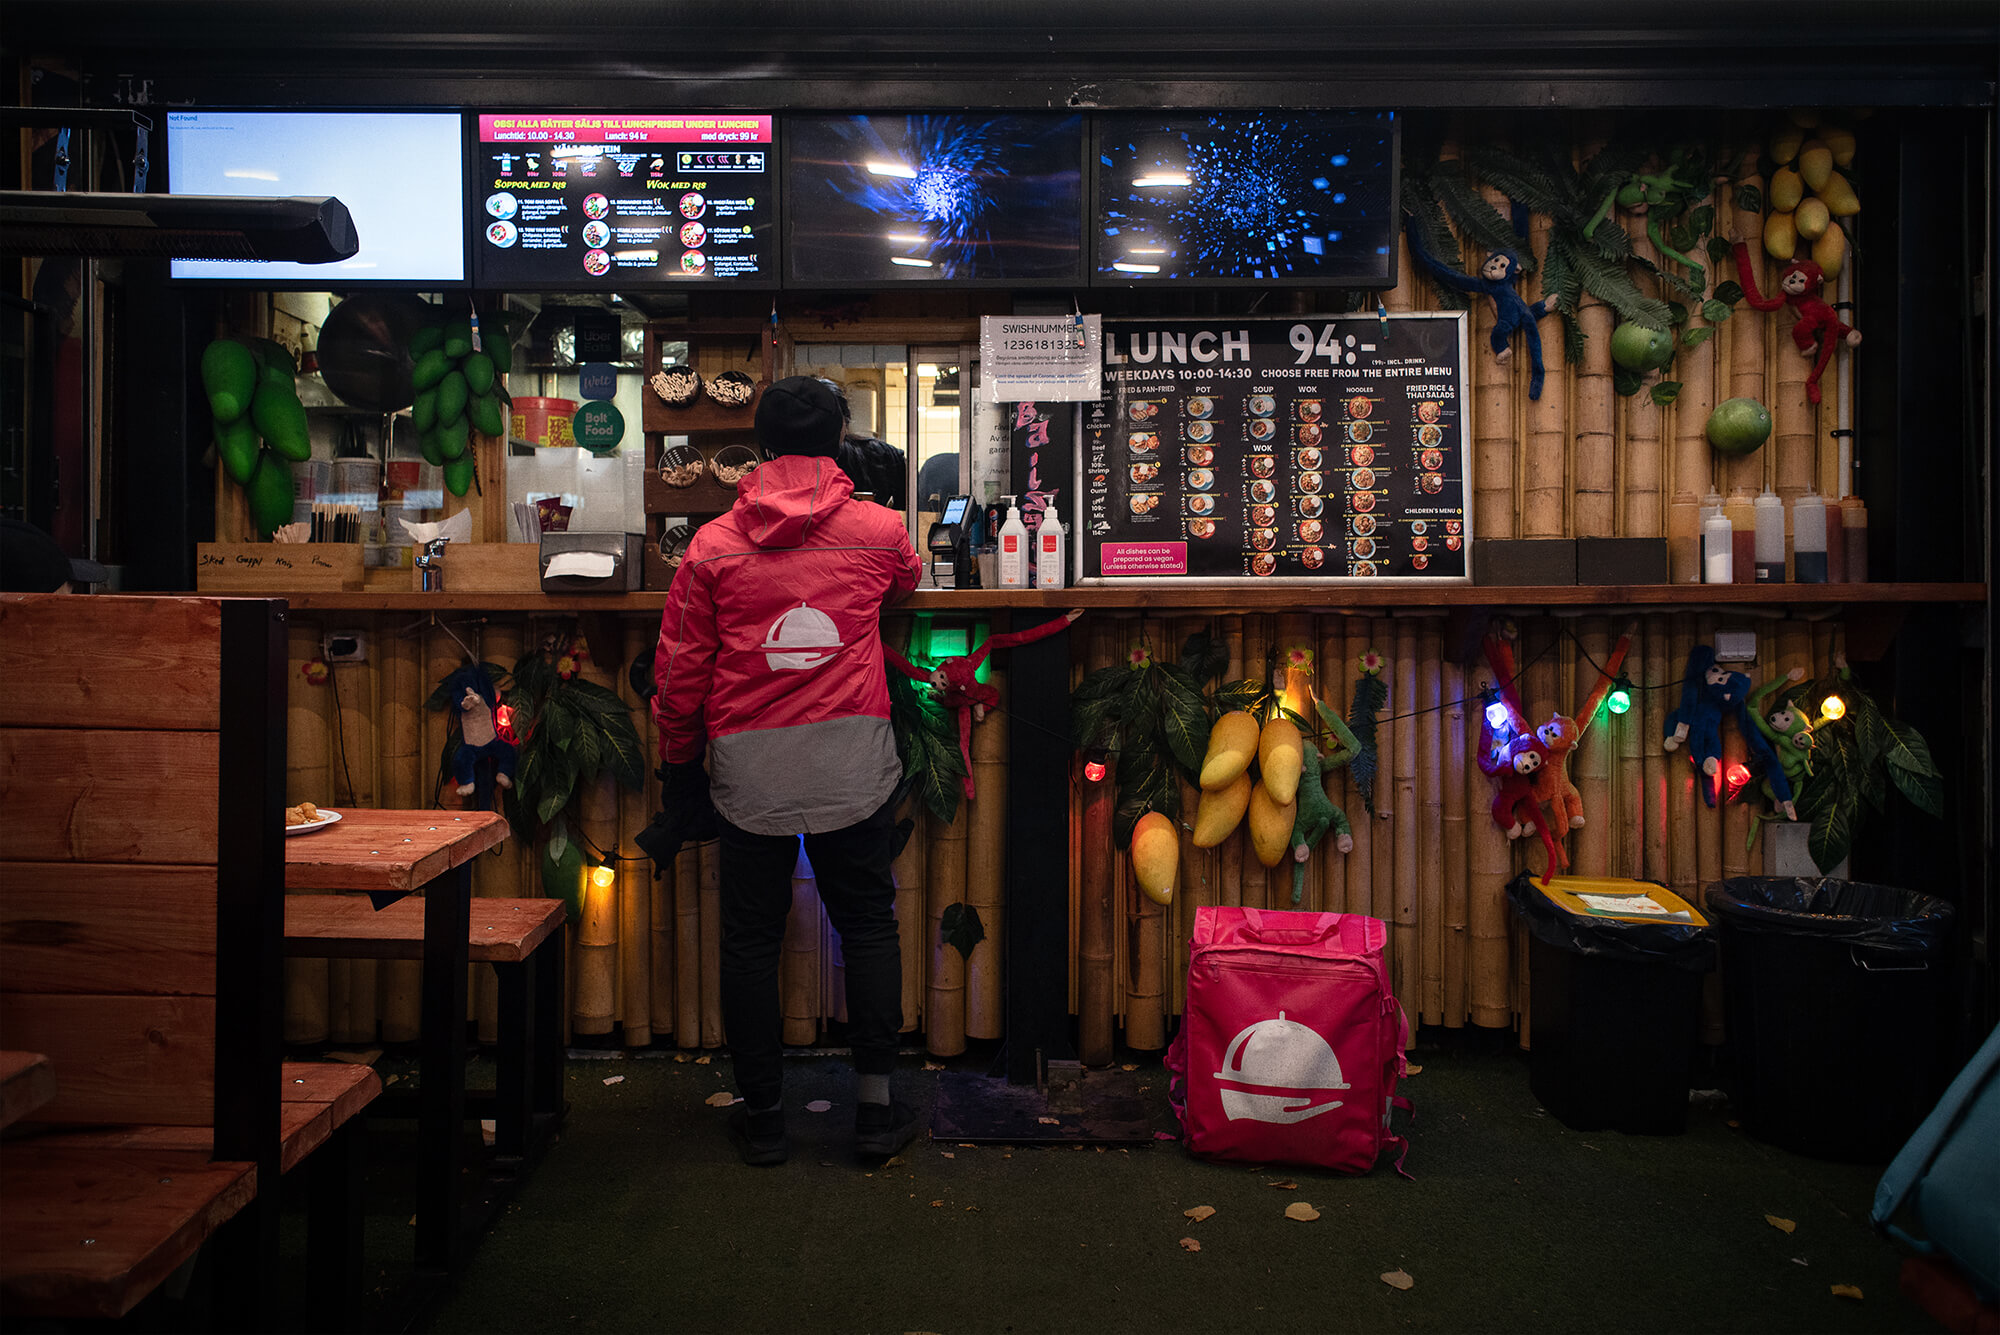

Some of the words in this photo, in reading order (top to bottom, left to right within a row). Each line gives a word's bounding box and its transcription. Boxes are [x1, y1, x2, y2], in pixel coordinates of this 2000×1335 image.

[493, 120, 515, 129] OBS!
[517, 120, 539, 129] ALLA
[540, 118, 574, 129] RÄTTER
[575, 118, 602, 129] SÄLJS
[603, 120, 621, 129] TILL
[622, 120, 684, 129] LUNCHPRISER
[685, 120, 716, 129] UNDER
[717, 120, 759, 129] LUNCHEN
[493, 131, 526, 141] Lunchtid:
[527, 131, 549, 140] 10.00
[554, 131, 575, 140] 14.30
[605, 131, 628, 140] Lunch:
[629, 131, 639, 140] 94
[640, 131, 649, 140] kr
[701, 132, 717, 140] med
[718, 131, 739, 142] dryck:
[739, 132, 750, 140] 99
[751, 132, 759, 140] kr
[1002, 324, 1079, 334] SWISHNUMMER
[583, 329, 612, 342] Uber
[583, 342, 613, 352] Eats
[1105, 329, 1251, 365] LUNCH
[1288, 323, 1376, 366] 94:-
[1404, 357, 1426, 365] DRINK)
[1104, 369, 1175, 382] WEEKDAYS
[1178, 367, 1252, 380] 10:00-14:30
[1261, 369, 1302, 379] CHOOSE
[1304, 369, 1330, 378] FREE
[1332, 369, 1360, 378] FROM
[1362, 368, 1382, 378] THE
[1385, 367, 1422, 378] ENTIRE
[1424, 366, 1452, 377] MENU
[583, 375, 613, 389] Wolt
[1142, 385, 1176, 393] PAN-FRIED
[584, 411, 608, 423] Bolt
[584, 424, 614, 435] Food
[1252, 444, 1273, 452] WOK
[1087, 467, 1110, 475] Shrimp
[1112, 555, 1143, 563] prepared
[1103, 563, 1127, 571] (unless
[1160, 561, 1184, 570] stated)
